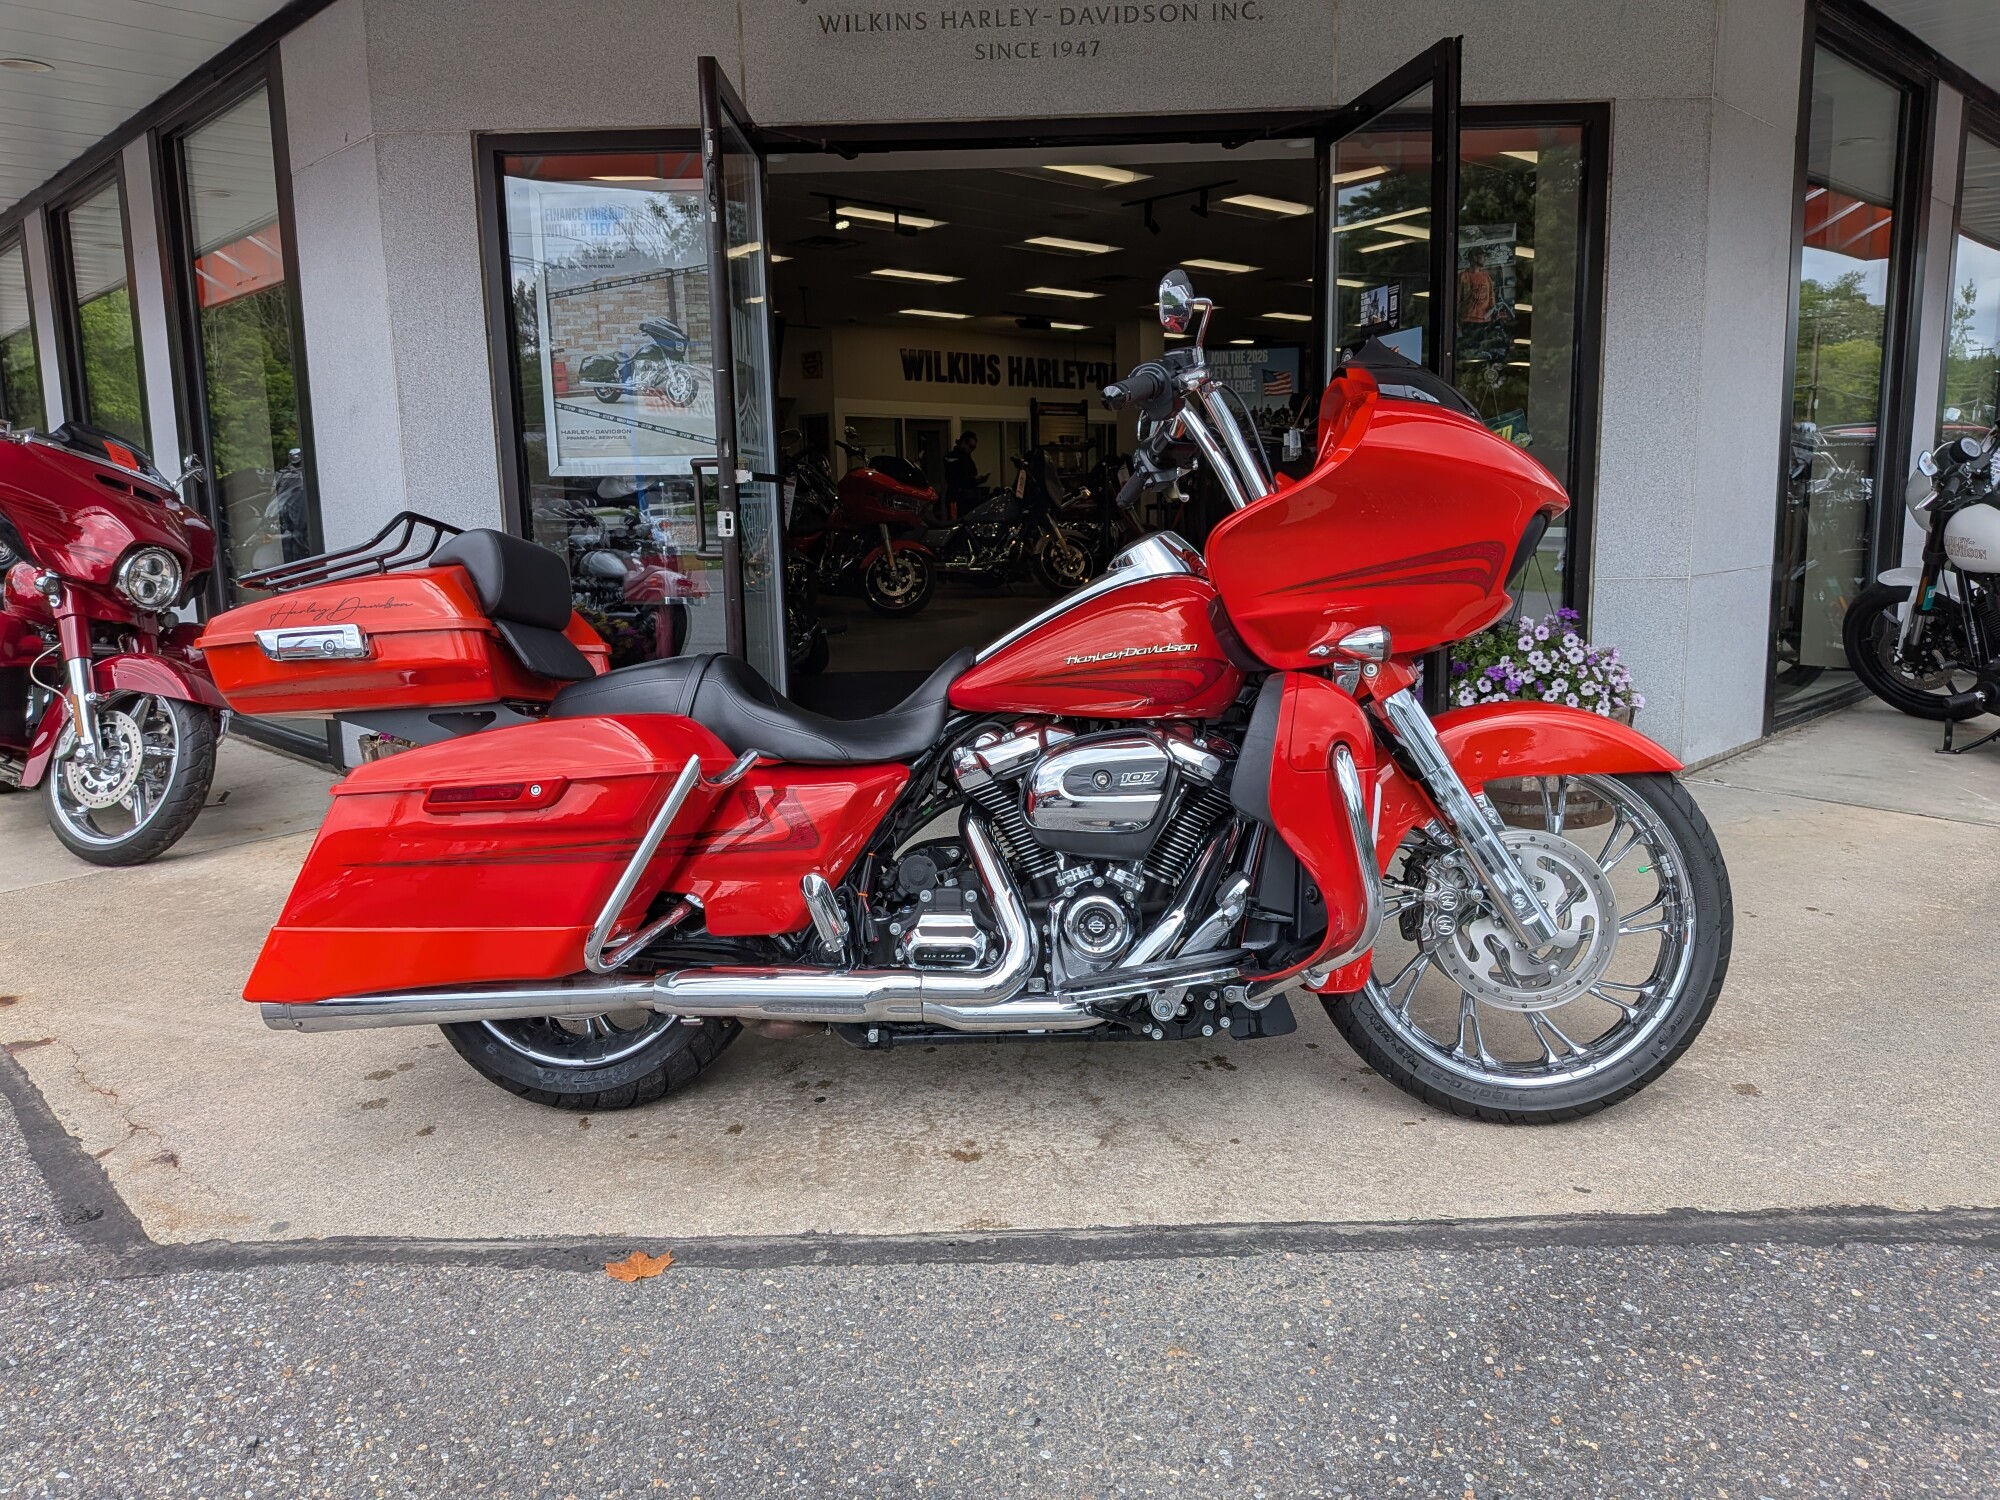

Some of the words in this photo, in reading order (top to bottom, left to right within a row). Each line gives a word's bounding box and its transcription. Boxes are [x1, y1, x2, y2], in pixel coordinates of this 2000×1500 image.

[817, 11, 929, 35] WILKINS
[940, 3, 1199, 31] HARLEY-DAVIDSON
[1211, 1, 1265, 22] INC.
[974, 42, 1042, 61] SINCE
[1051, 40, 1101, 59] 1947
[545, 207, 583, 221] FINANCE
[590, 222, 612, 236] FLEX
[1209, 351, 1229, 365] JOIN
[1230, 350, 1246, 364] THE
[1247, 349, 1269, 364] 2026
[900, 348, 1001, 386] WILKINS
[1233, 364, 1253, 379] RIDE
[1120, 771, 1159, 783] 107
